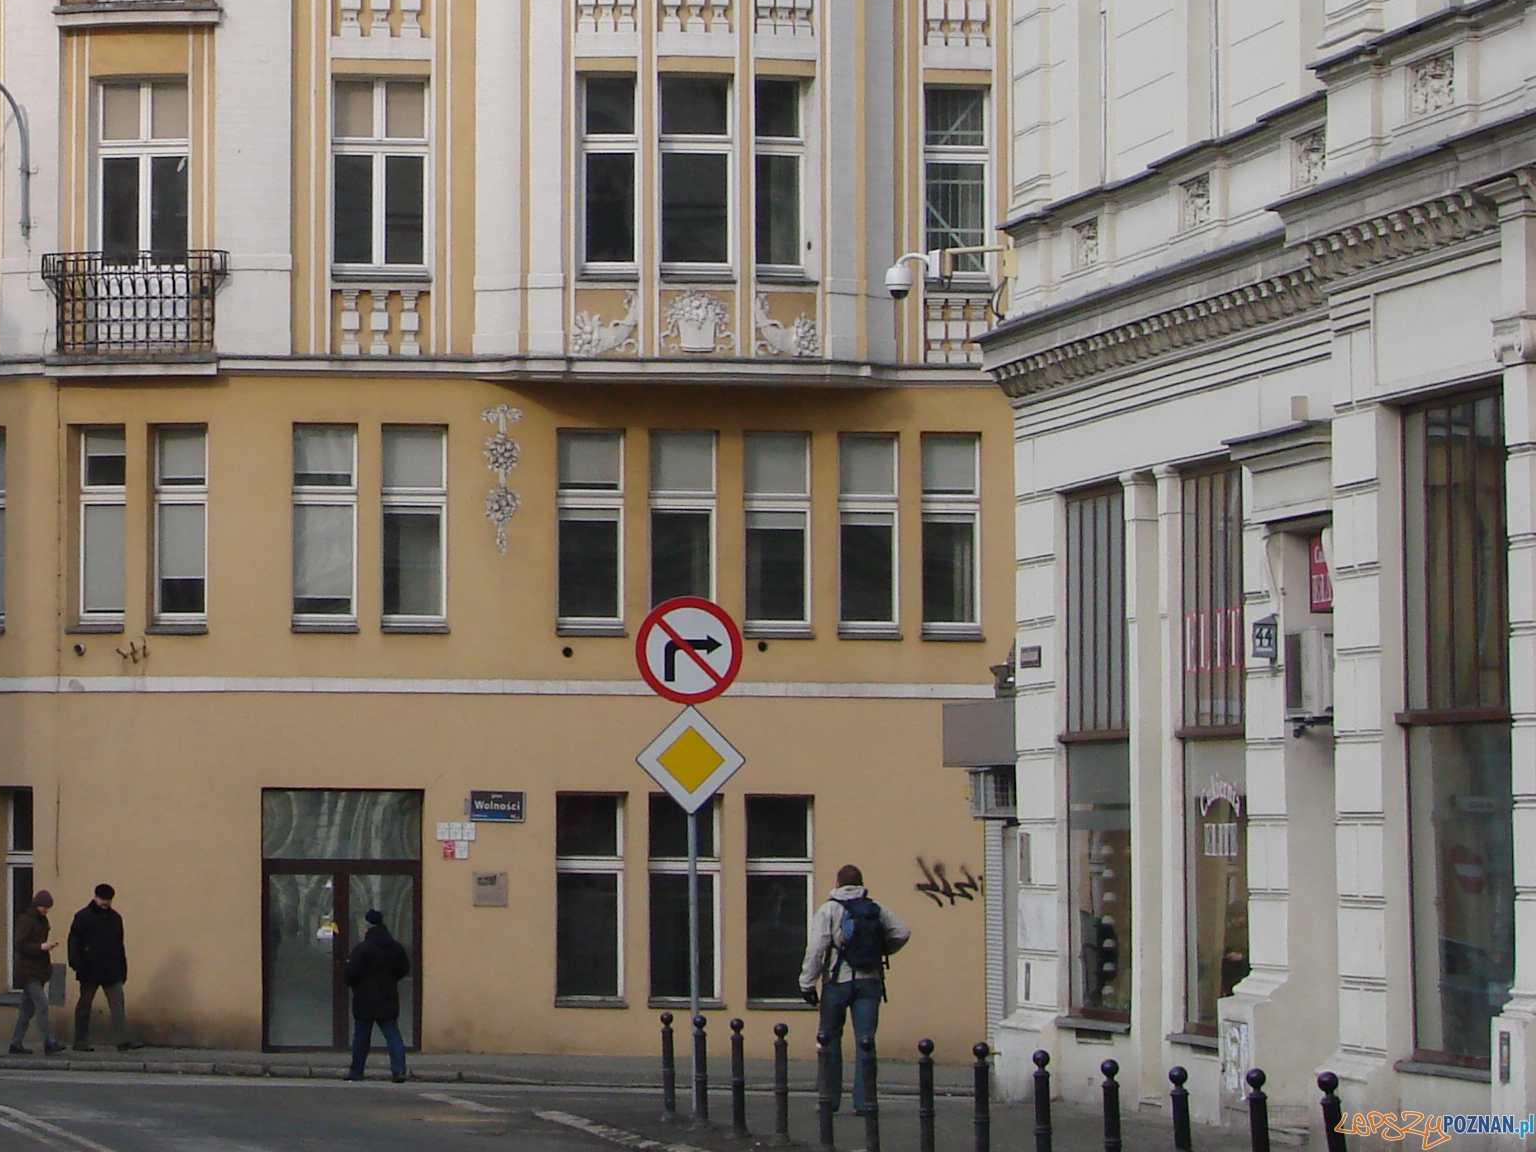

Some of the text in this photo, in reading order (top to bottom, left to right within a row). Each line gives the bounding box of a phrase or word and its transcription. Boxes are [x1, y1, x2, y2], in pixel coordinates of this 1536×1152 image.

[1255, 627, 1274, 648] 44
[474, 799, 521, 811] Wolności
[1204, 822, 1238, 857] ELITE
